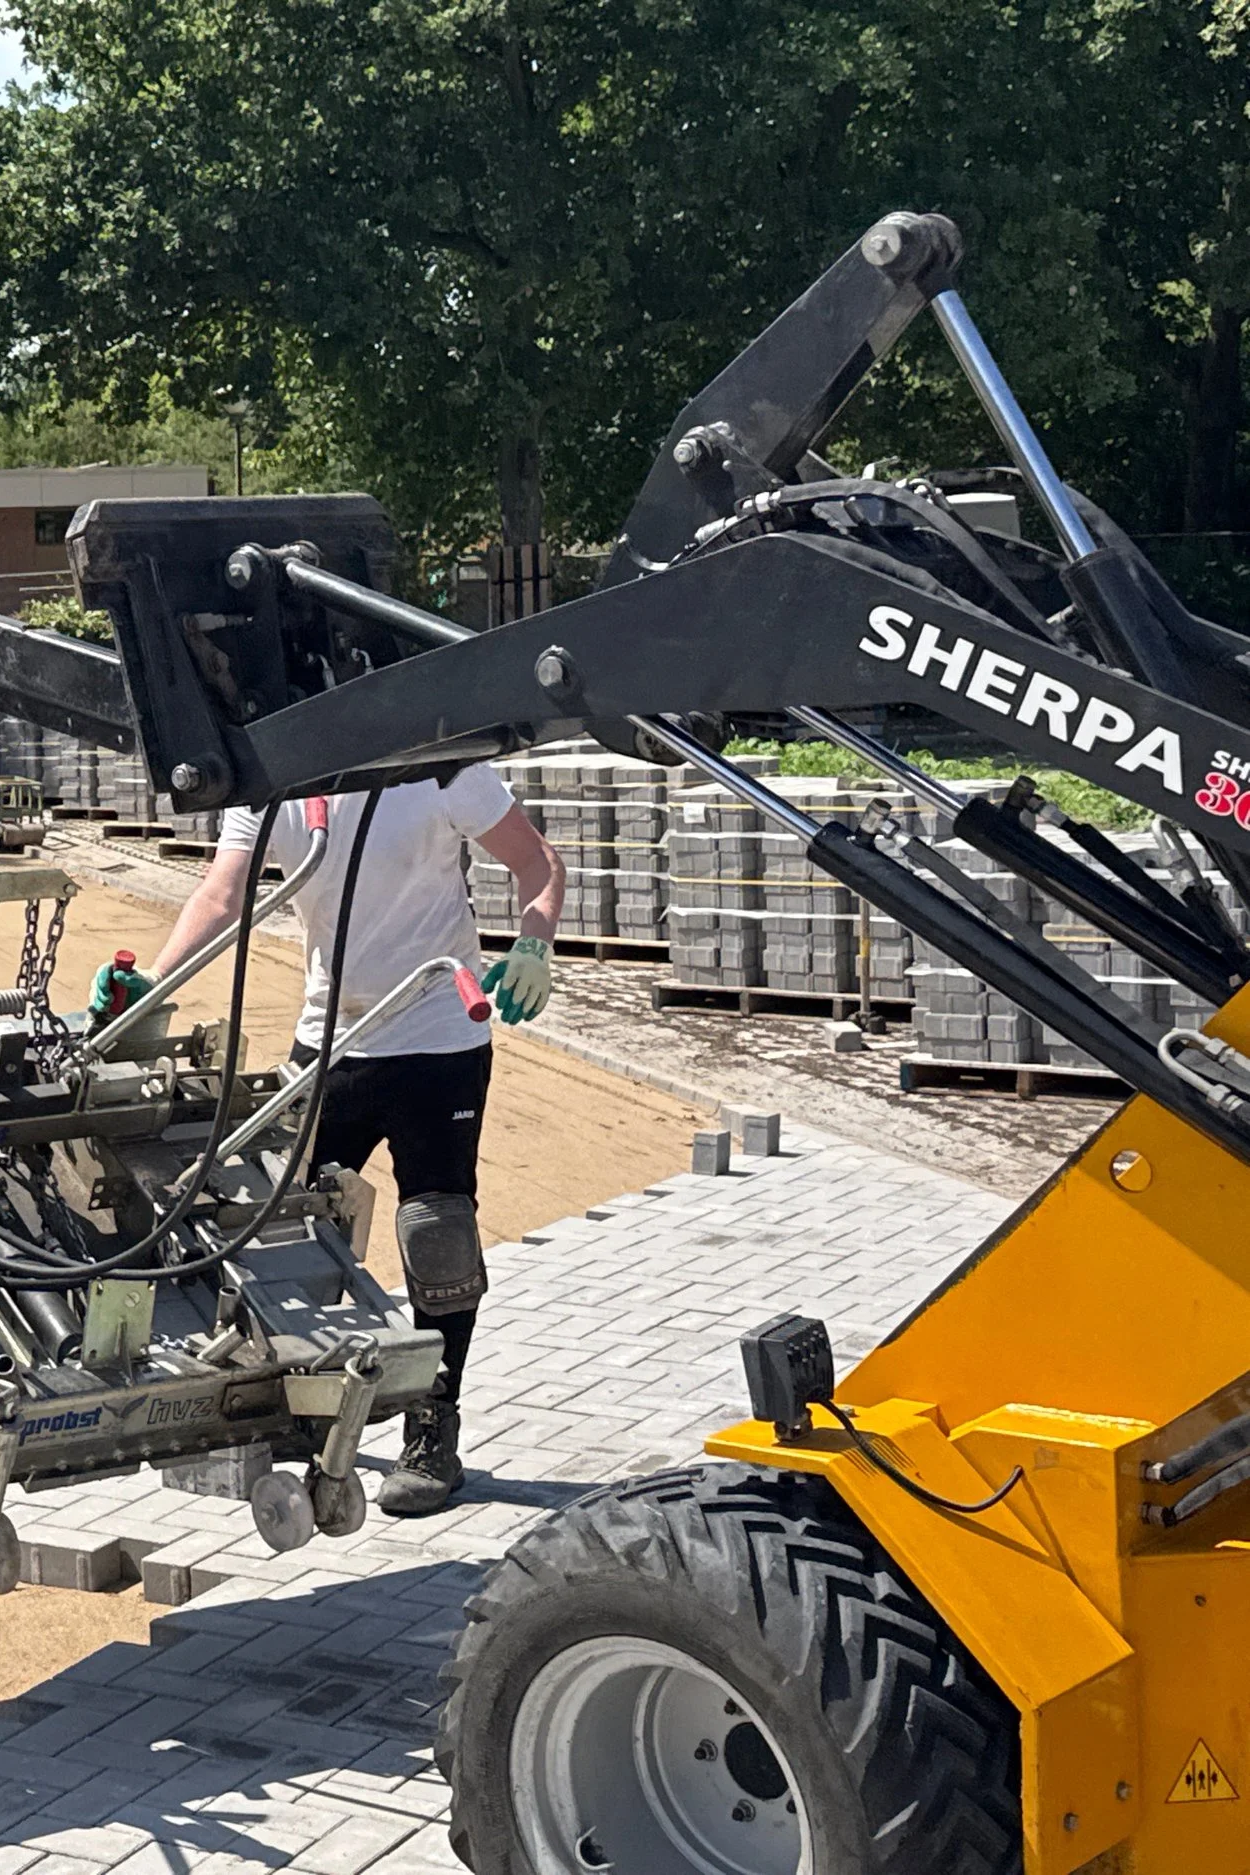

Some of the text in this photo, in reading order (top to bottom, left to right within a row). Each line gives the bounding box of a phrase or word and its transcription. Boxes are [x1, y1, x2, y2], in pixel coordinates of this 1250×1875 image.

[858, 605, 1183, 795] SHERPA
[1211, 750, 1250, 783] SH
[18, 1407, 103, 1447] probst
